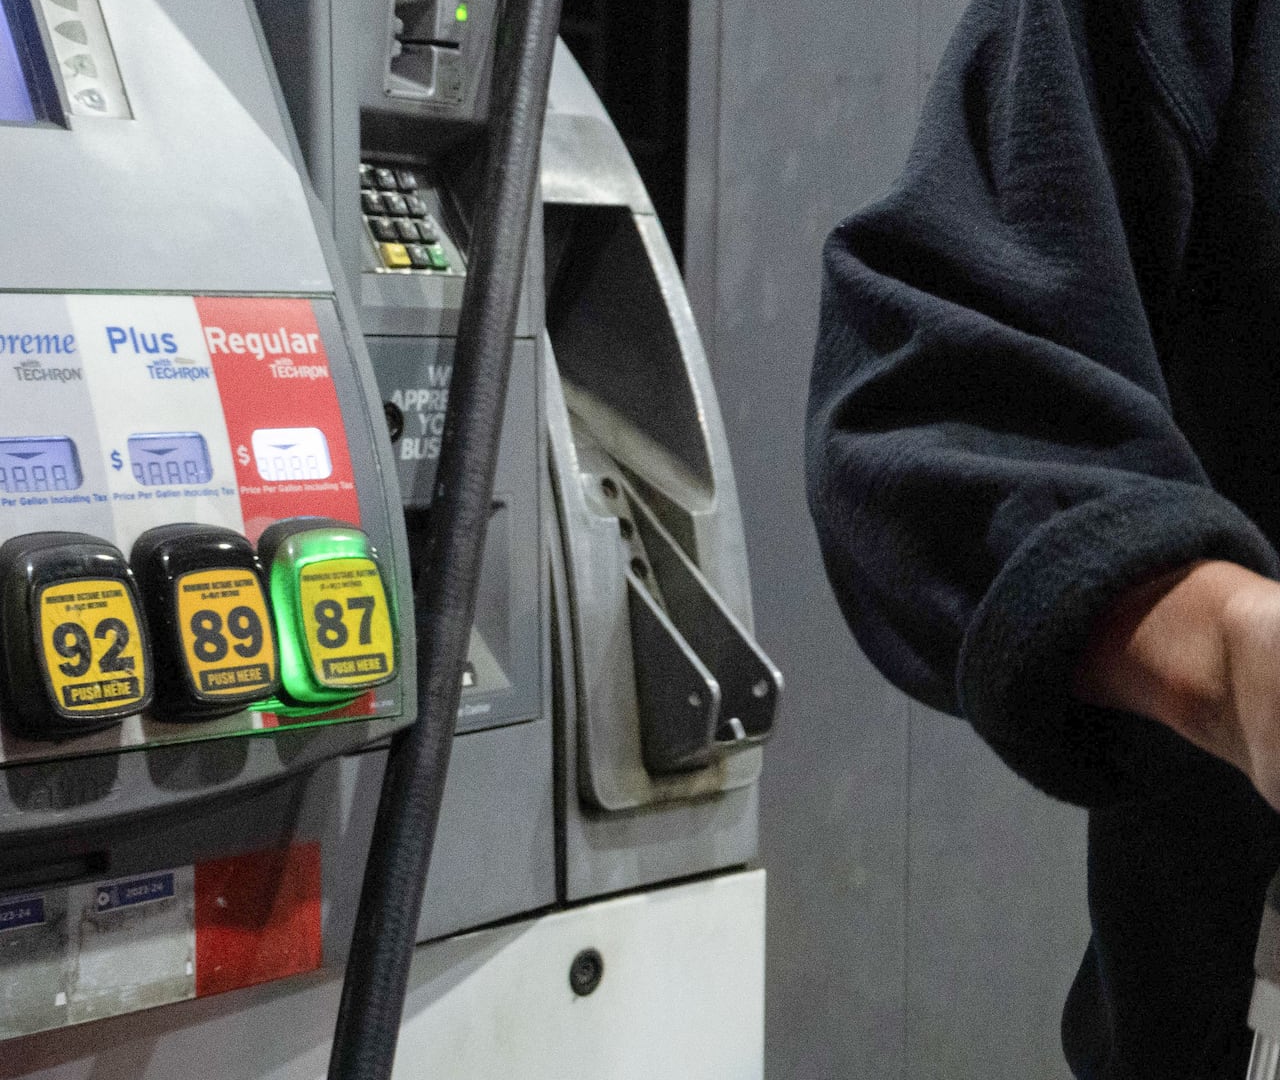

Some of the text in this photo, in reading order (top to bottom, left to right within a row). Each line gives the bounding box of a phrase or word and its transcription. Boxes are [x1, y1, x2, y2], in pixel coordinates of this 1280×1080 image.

[106, 325, 178, 354] Plus
[203, 326, 320, 361] Regular
[13, 366, 83, 383] TECHRON
[147, 365, 210, 382] TECHRON
[268, 363, 330, 381] TECHRON
[110, 449, 124, 471] $
[236, 444, 251, 466] $
[113, 492, 135, 501] Price
[138, 491, 152, 500] Per
[156, 489, 182, 499] Gallon
[221, 486, 235, 496] Tax
[240, 481, 354, 494] Price Per Gallon Including Tax
[2, 493, 107, 507] Per Gallon Including Tax
[314, 595, 376, 649] 87
[190, 605, 264, 663] 89
[52, 617, 135, 677] 92
[207, 667, 263, 686] PUSH HERE
[329, 658, 382, 675] PUSH HERE
[70, 680, 132, 702] PUSH HERE
